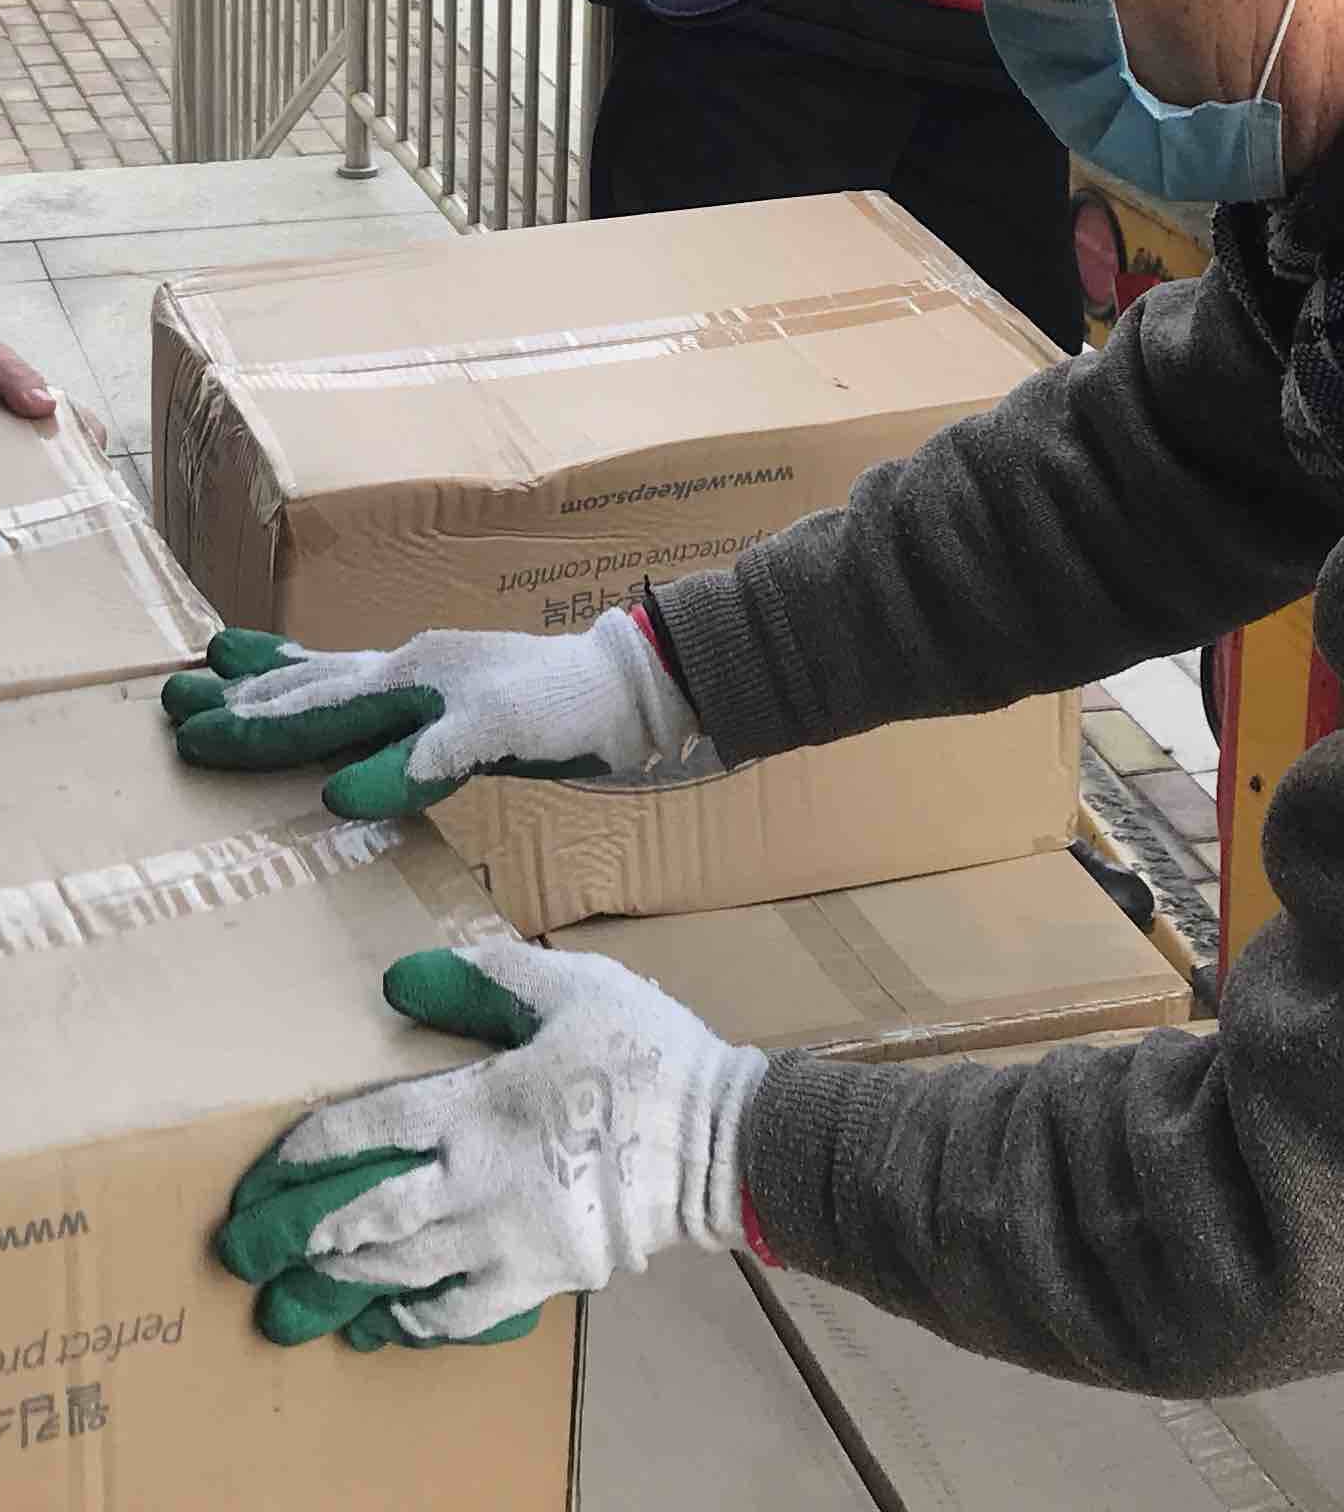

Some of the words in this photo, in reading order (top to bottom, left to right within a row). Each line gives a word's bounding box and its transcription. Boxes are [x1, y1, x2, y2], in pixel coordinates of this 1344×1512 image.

[560, 466, 793, 516] www.welkeeps.com
[497, 560, 592, 595] comfort
[595, 551, 643, 580] and
[56, 1307, 185, 1367] Perfect
